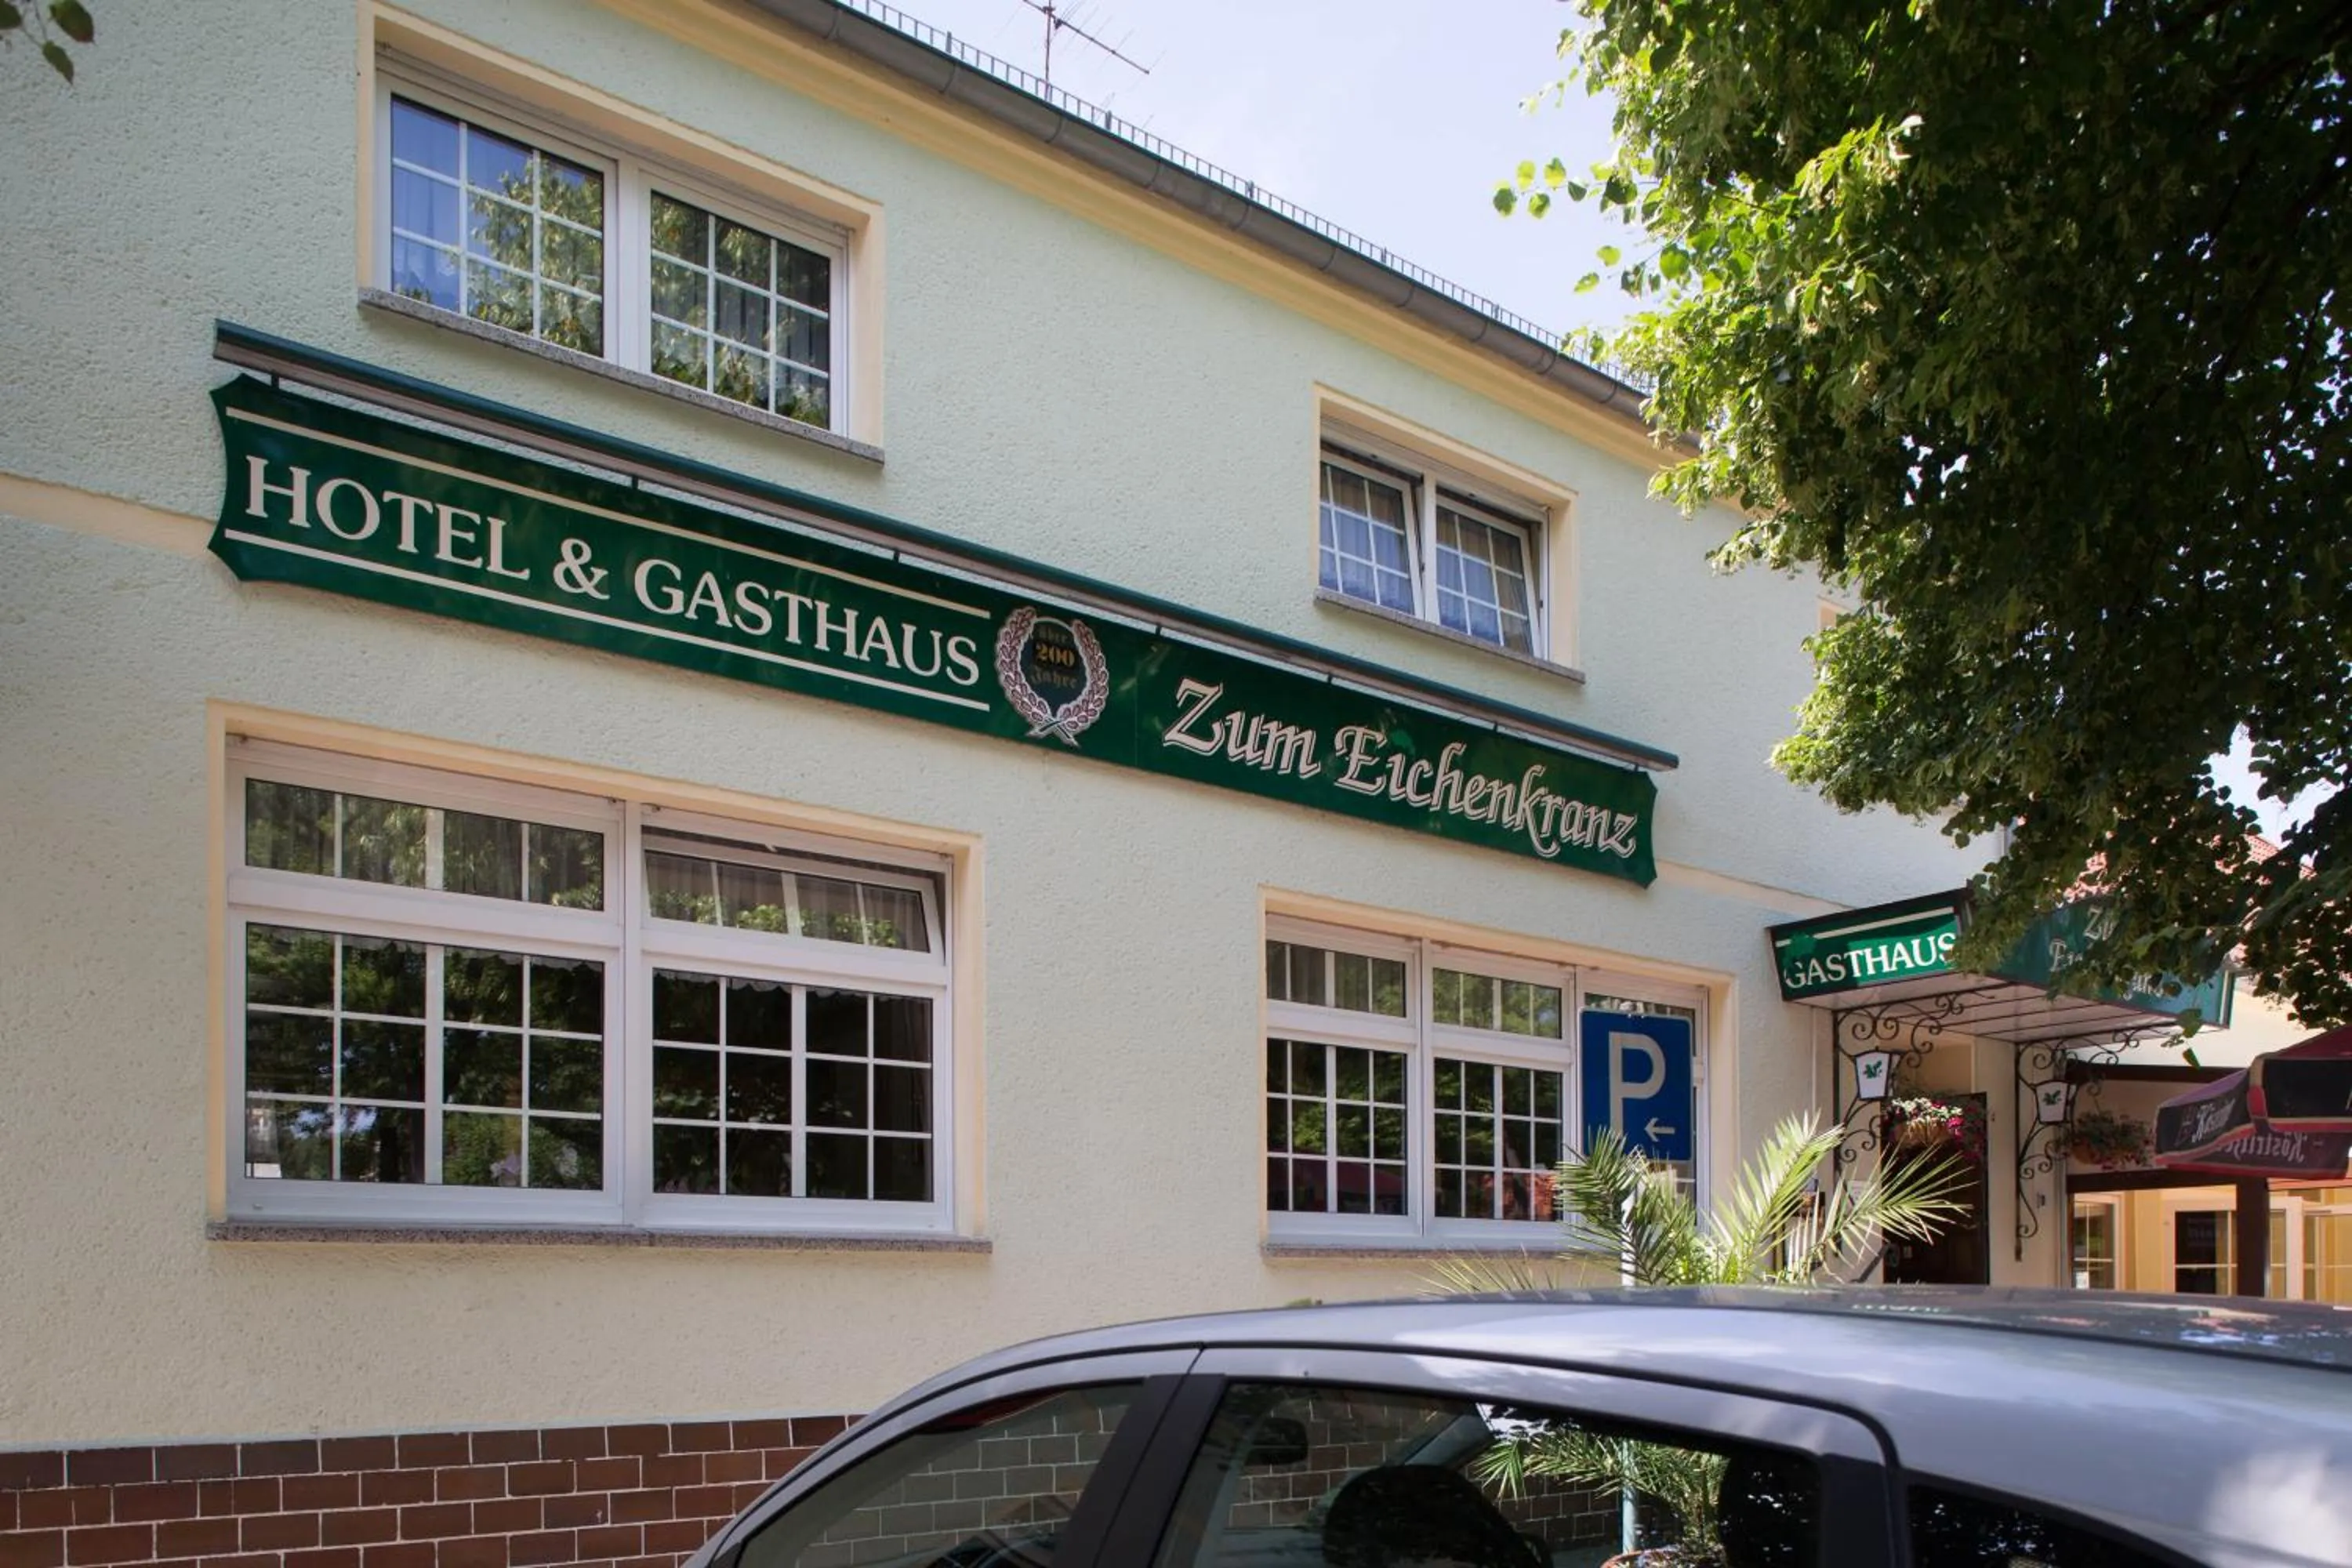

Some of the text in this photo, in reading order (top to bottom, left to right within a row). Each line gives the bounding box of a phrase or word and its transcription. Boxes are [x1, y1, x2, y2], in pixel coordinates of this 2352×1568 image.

[245, 455, 979, 686] HOTEL & GASTHAUS
[1036, 643, 1075, 667] 200
[1163, 677, 1637, 858] Zum Eichenkranz
[1784, 932, 1957, 989] GASTHAUS
[1609, 1031, 1666, 1141] P
